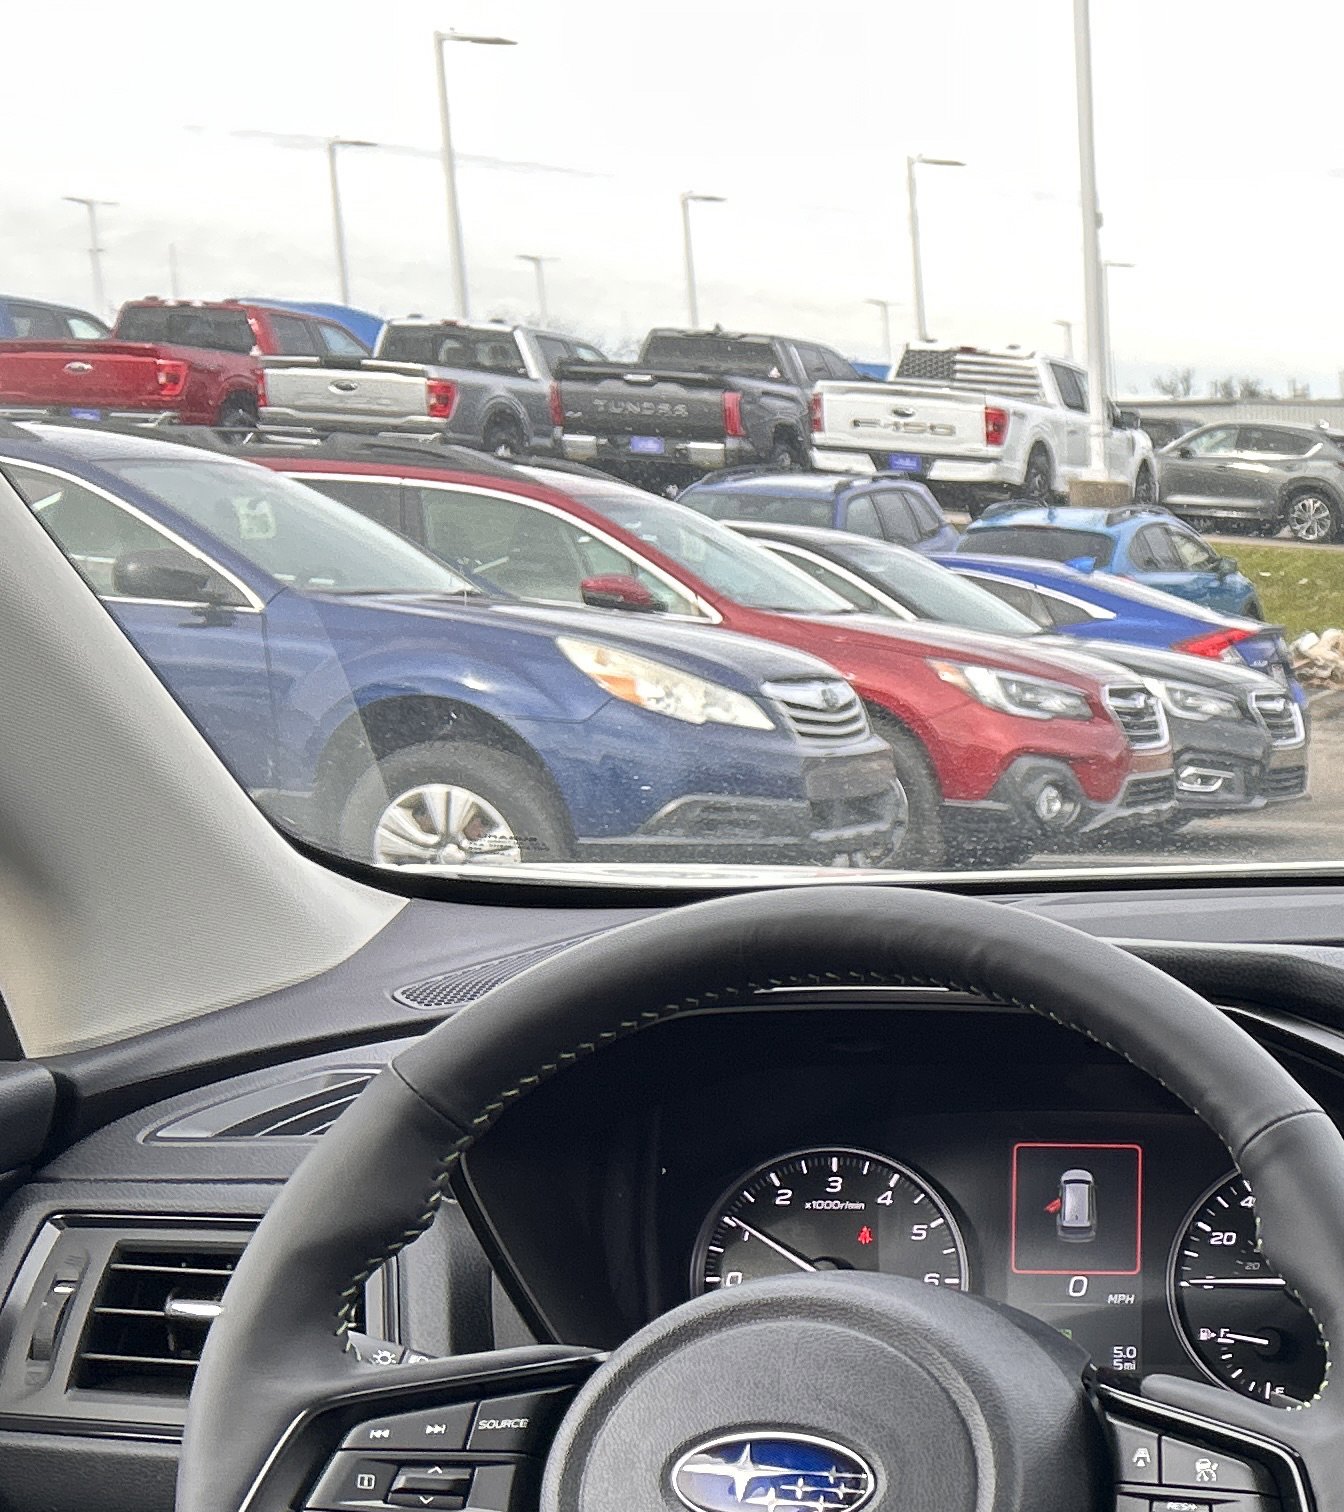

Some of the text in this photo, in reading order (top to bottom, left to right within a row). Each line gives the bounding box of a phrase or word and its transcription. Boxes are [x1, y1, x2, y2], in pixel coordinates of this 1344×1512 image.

[825, 1176, 843, 1192] 3
[775, 1190, 793, 1205] 2
[877, 1190, 894, 1205] 4
[911, 1224, 928, 1240] 5
[1209, 1231, 1237, 1245] 20
[1069, 1276, 1088, 1297] 0
[1107, 1294, 1135, 1304] MPH
[1113, 1346, 1137, 1358] 5.0
[478, 1417, 530, 1430] SOURCE
